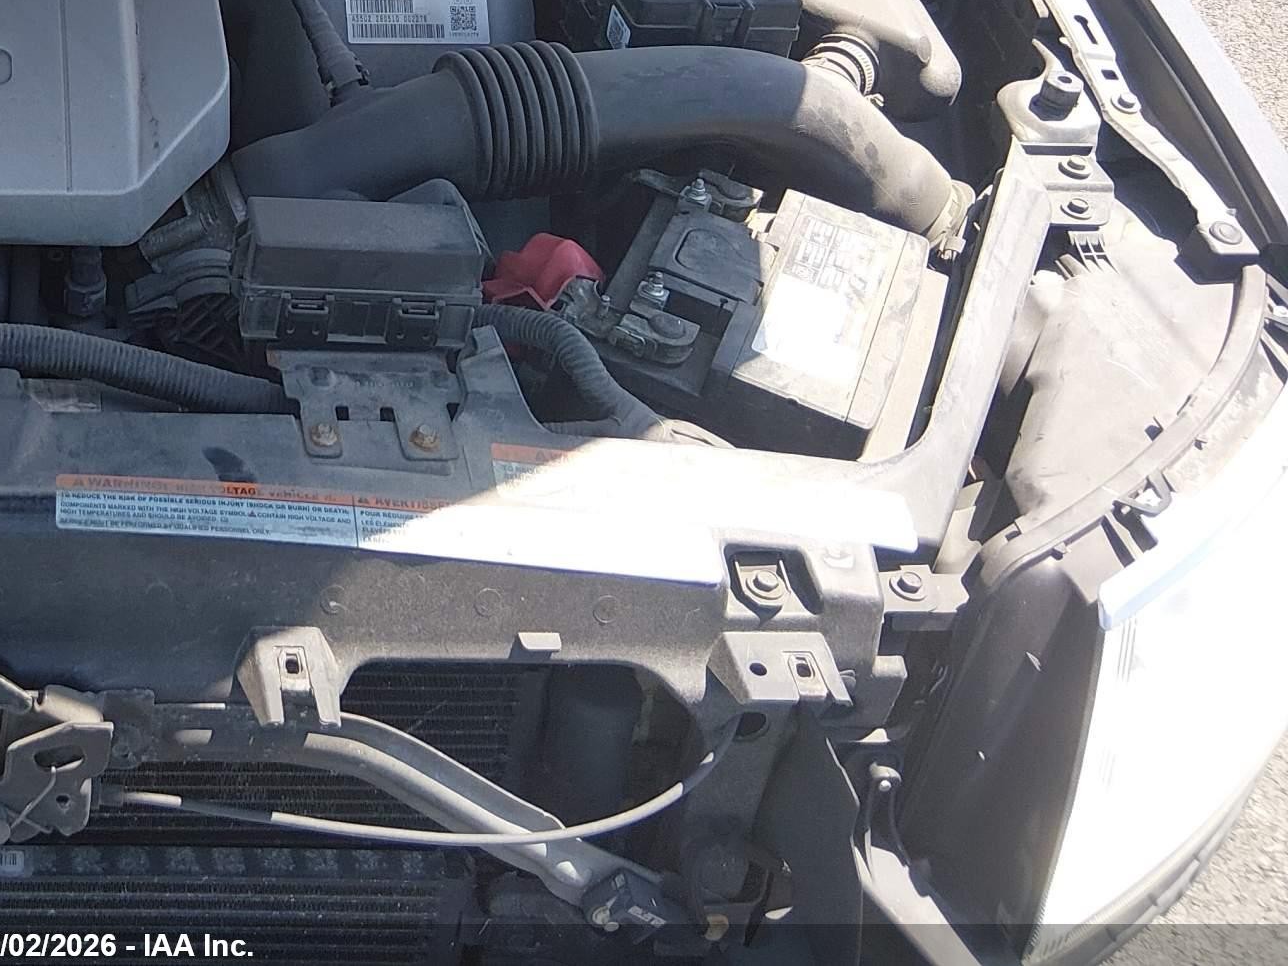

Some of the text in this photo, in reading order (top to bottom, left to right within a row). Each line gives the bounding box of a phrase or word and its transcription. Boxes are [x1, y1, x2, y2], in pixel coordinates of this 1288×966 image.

[78, 509, 131, 518] TEMPERATURES
[219, 509, 247, 517] SYMBOL
[305, 515, 336, 523] VOLTAGE
